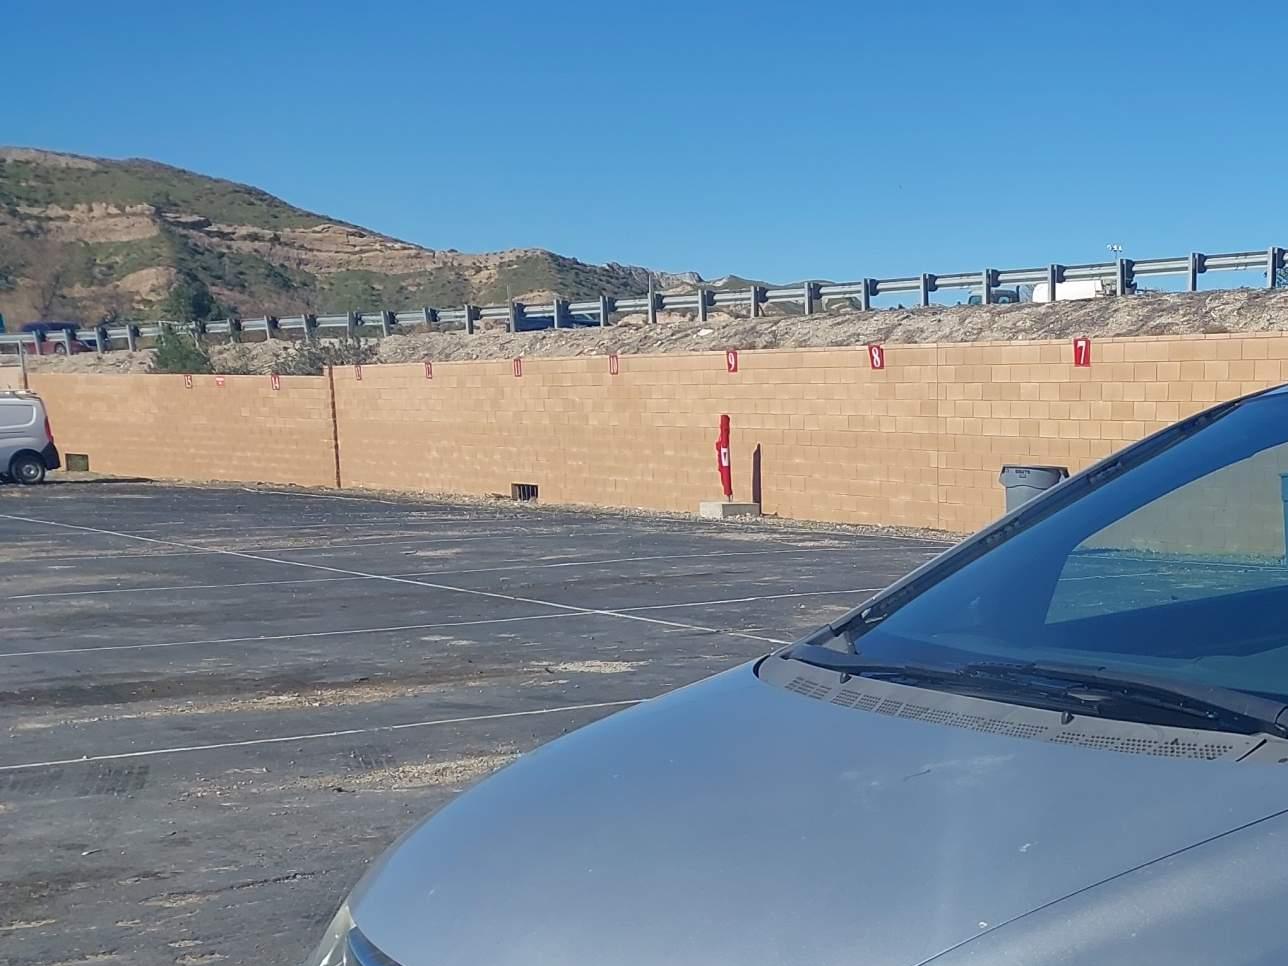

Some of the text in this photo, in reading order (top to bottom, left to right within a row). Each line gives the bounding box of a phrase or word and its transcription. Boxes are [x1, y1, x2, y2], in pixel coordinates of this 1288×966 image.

[728, 352, 735, 371] 9
[871, 347, 881, 368] 8
[1077, 341, 1086, 364] 7
